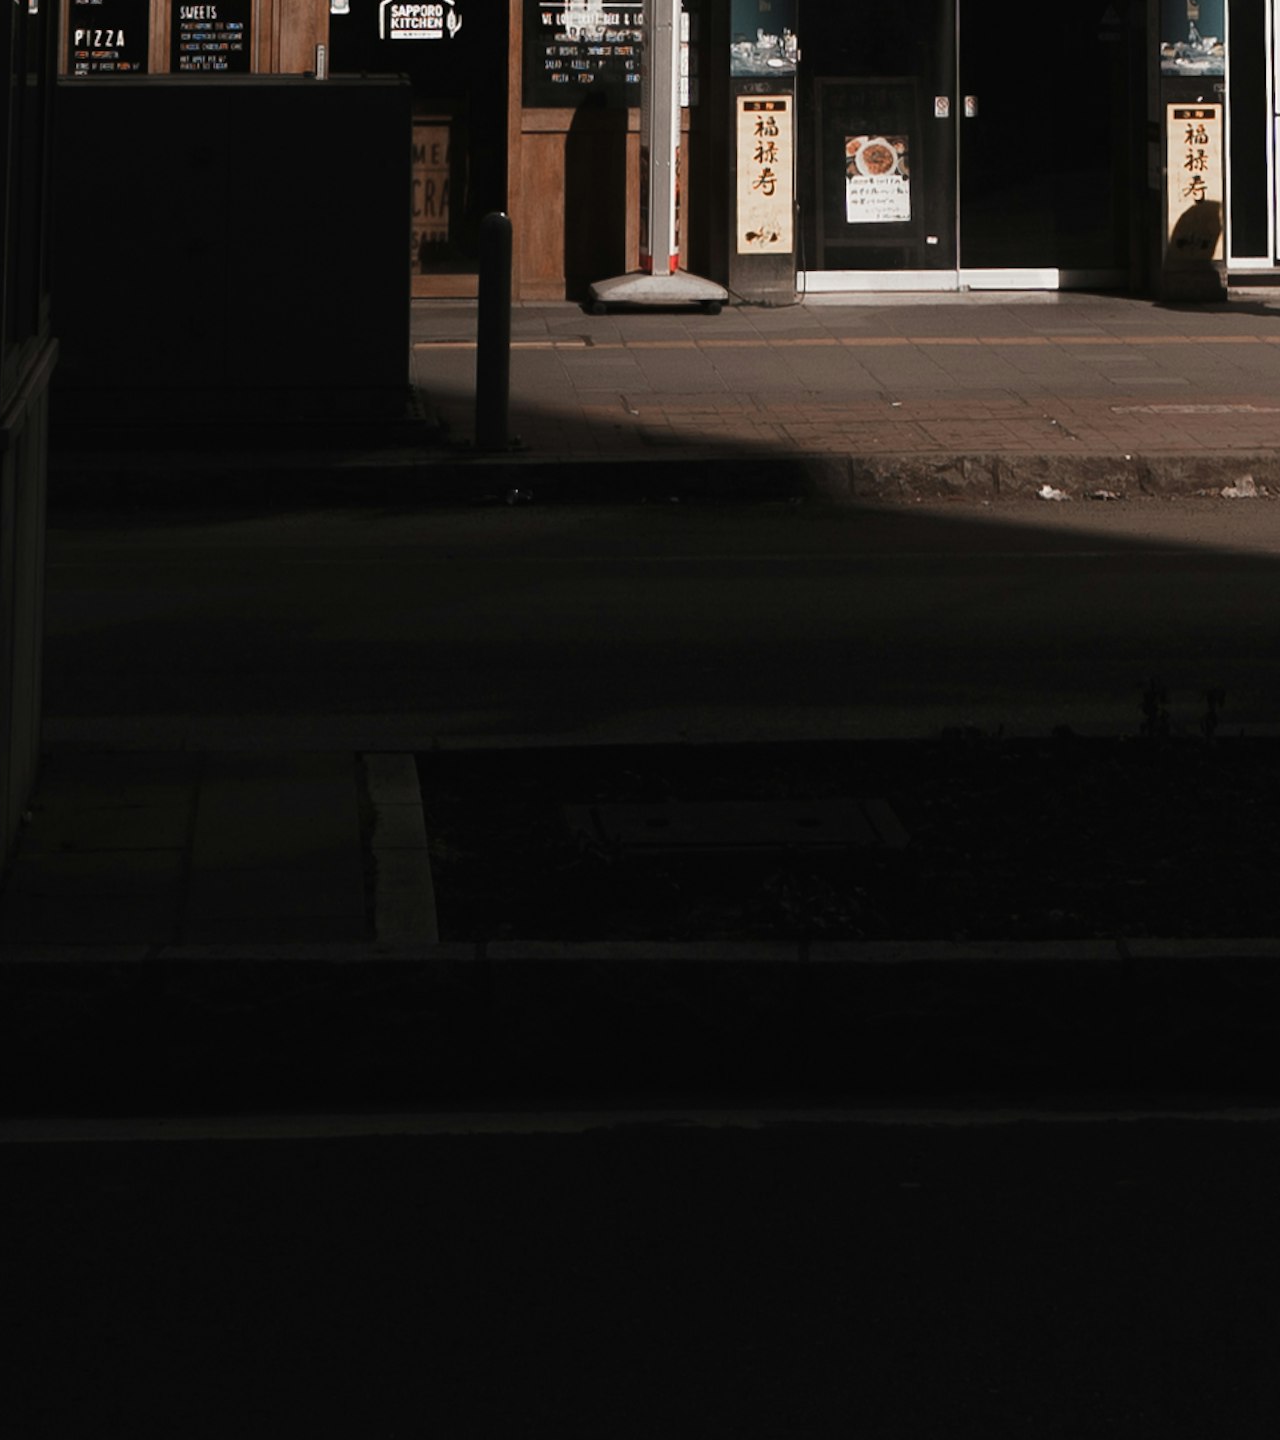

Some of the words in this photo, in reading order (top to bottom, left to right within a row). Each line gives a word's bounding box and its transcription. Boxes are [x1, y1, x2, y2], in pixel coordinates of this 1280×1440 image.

[180, 5, 218, 20] SWEETS
[391, 4, 443, 18] SAPPORO
[391, 17, 443, 29] KITCHEN
[75, 30, 125, 47] PIZZA
